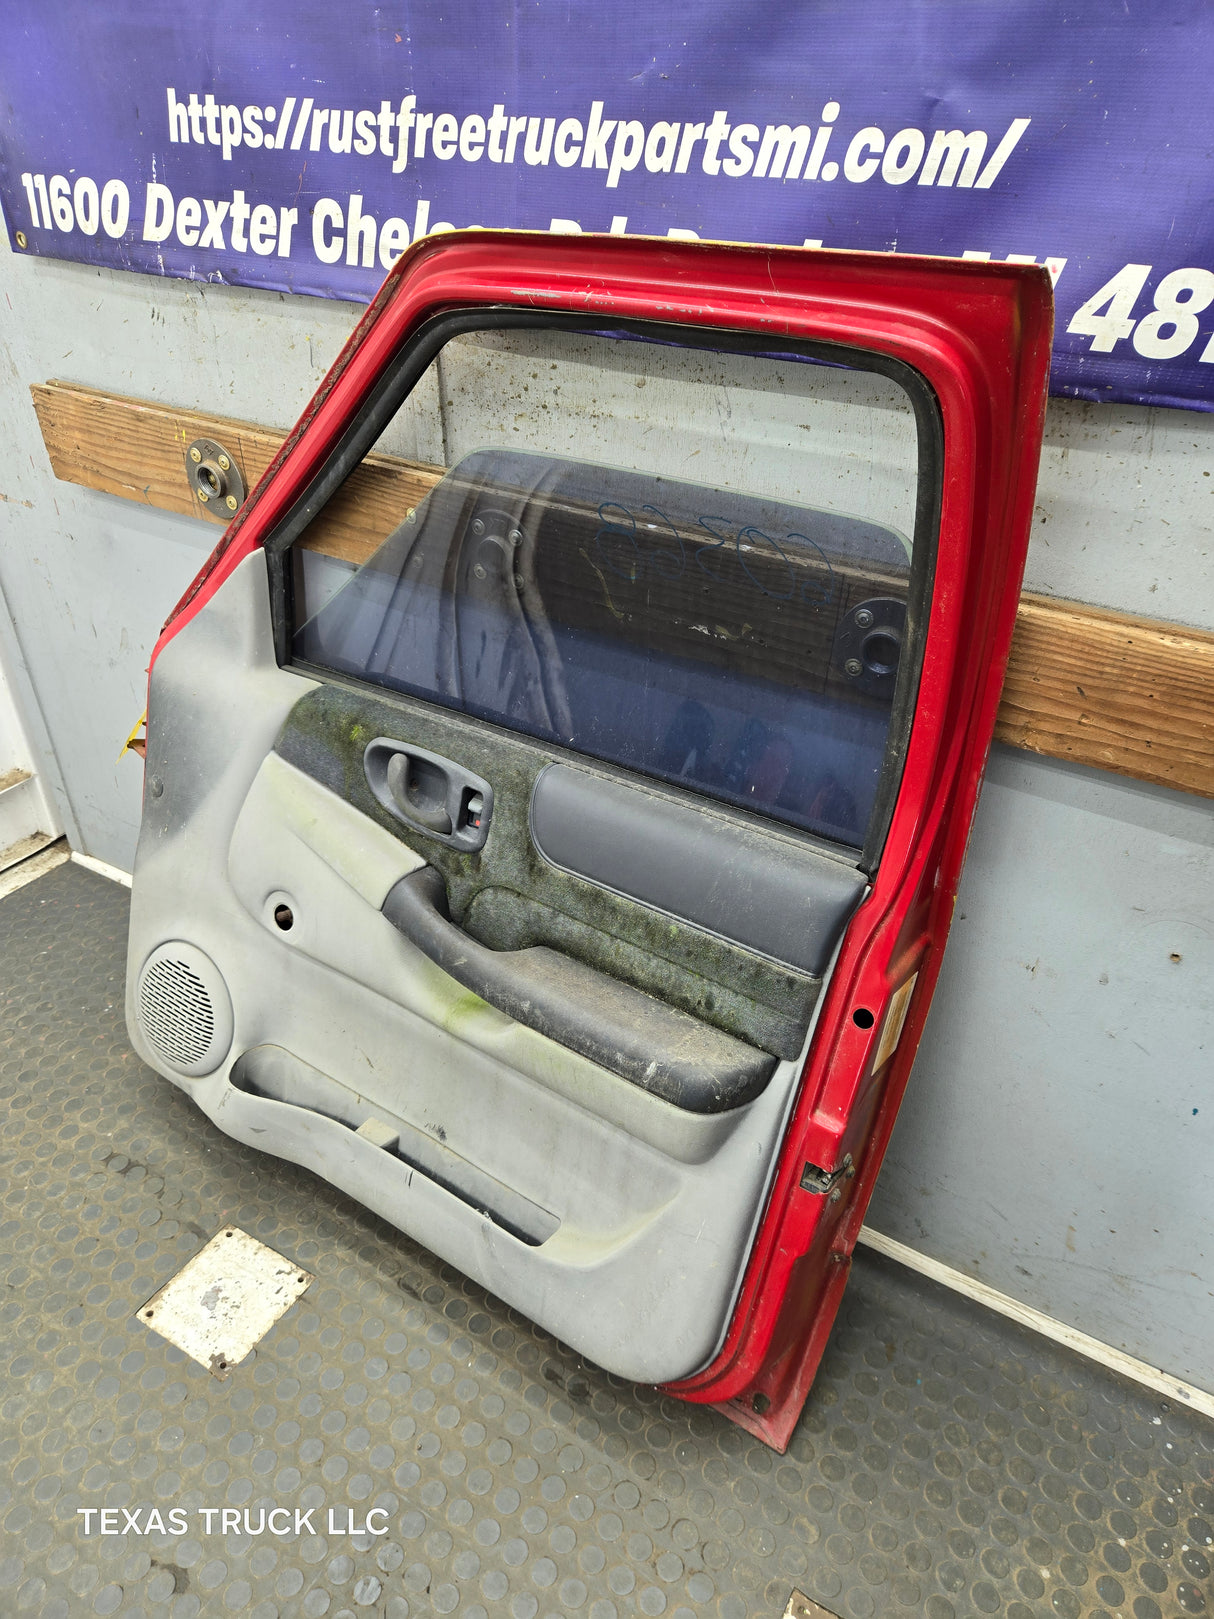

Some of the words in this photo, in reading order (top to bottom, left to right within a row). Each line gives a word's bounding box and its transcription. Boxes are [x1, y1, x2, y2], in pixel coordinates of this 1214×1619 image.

[166, 87, 1031, 190] https://rustfreetruckpartsmi.com/
[21, 172, 130, 239] 11600
[142, 182, 298, 258] Dexter
